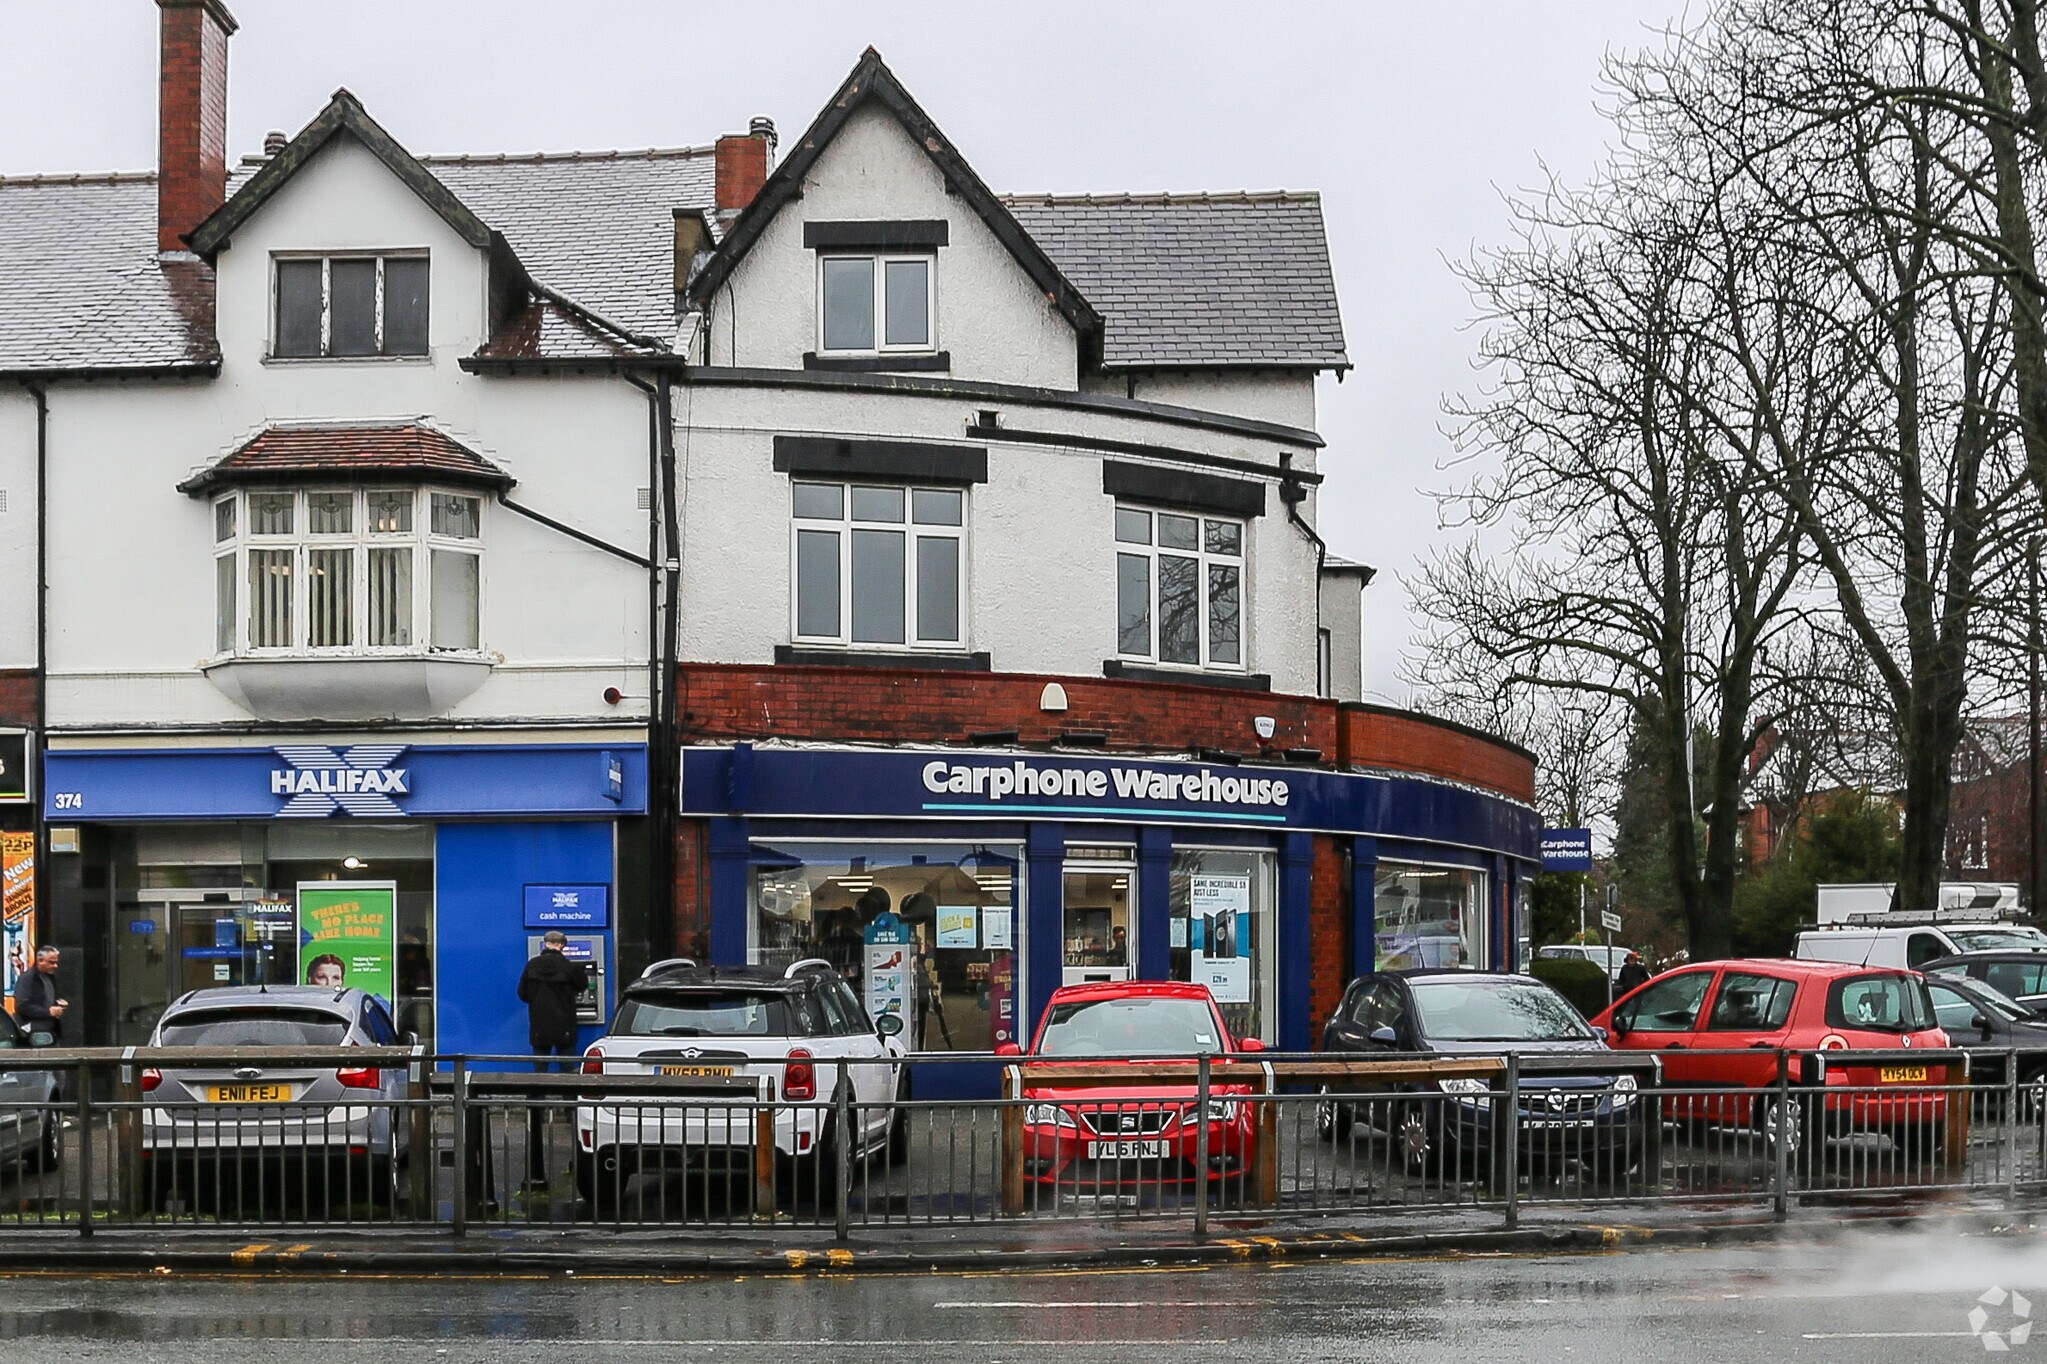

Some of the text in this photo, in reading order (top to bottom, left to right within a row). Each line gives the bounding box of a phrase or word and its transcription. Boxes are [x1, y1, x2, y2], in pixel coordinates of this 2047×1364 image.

[271, 770, 407, 793] HALIFAX
[922, 761, 1289, 806] Carphone Warehouse
[55, 793, 82, 808] 374
[253, 905, 292, 913] HALIFAX
[345, 914, 384, 924] PLACE
[540, 912, 592, 920] cash machine
